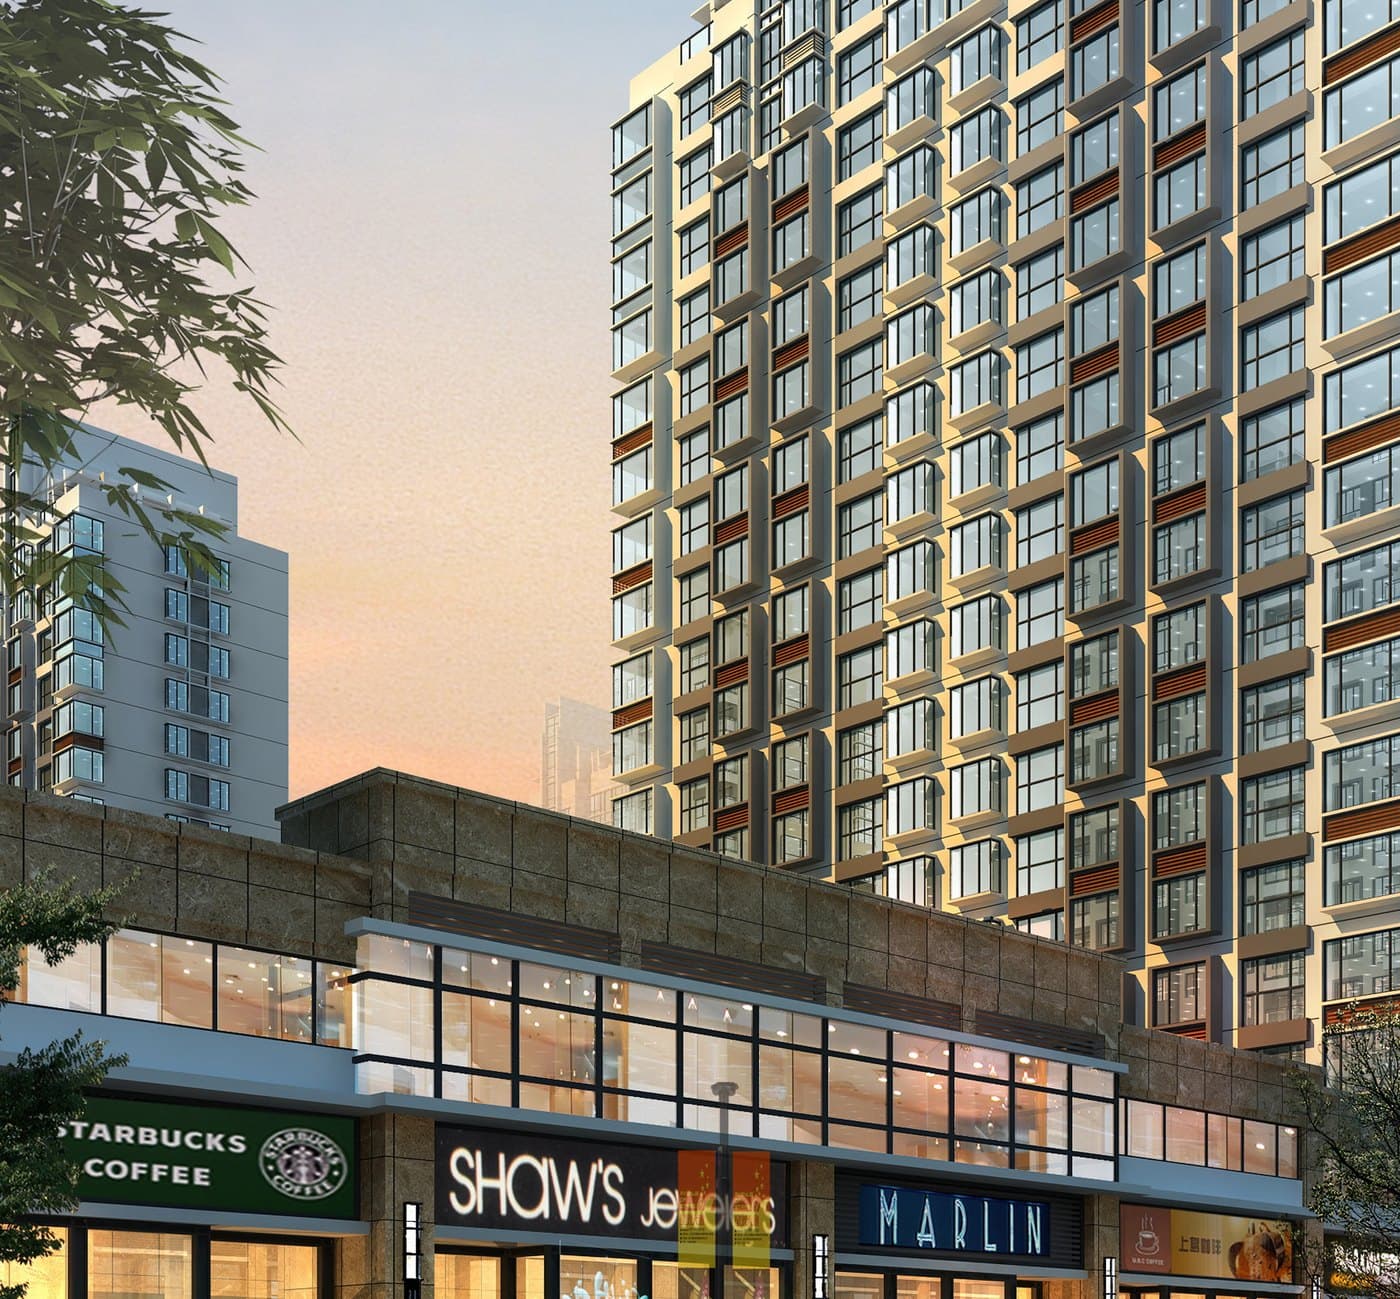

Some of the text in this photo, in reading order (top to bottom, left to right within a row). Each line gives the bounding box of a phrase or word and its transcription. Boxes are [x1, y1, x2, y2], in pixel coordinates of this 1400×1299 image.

[265, 1131, 340, 1165] STARBUCKS
[84, 1158, 211, 1186] COFFEE
[273, 1175, 333, 1196] COFFEE
[879, 1188, 1042, 1255] MARLIN
